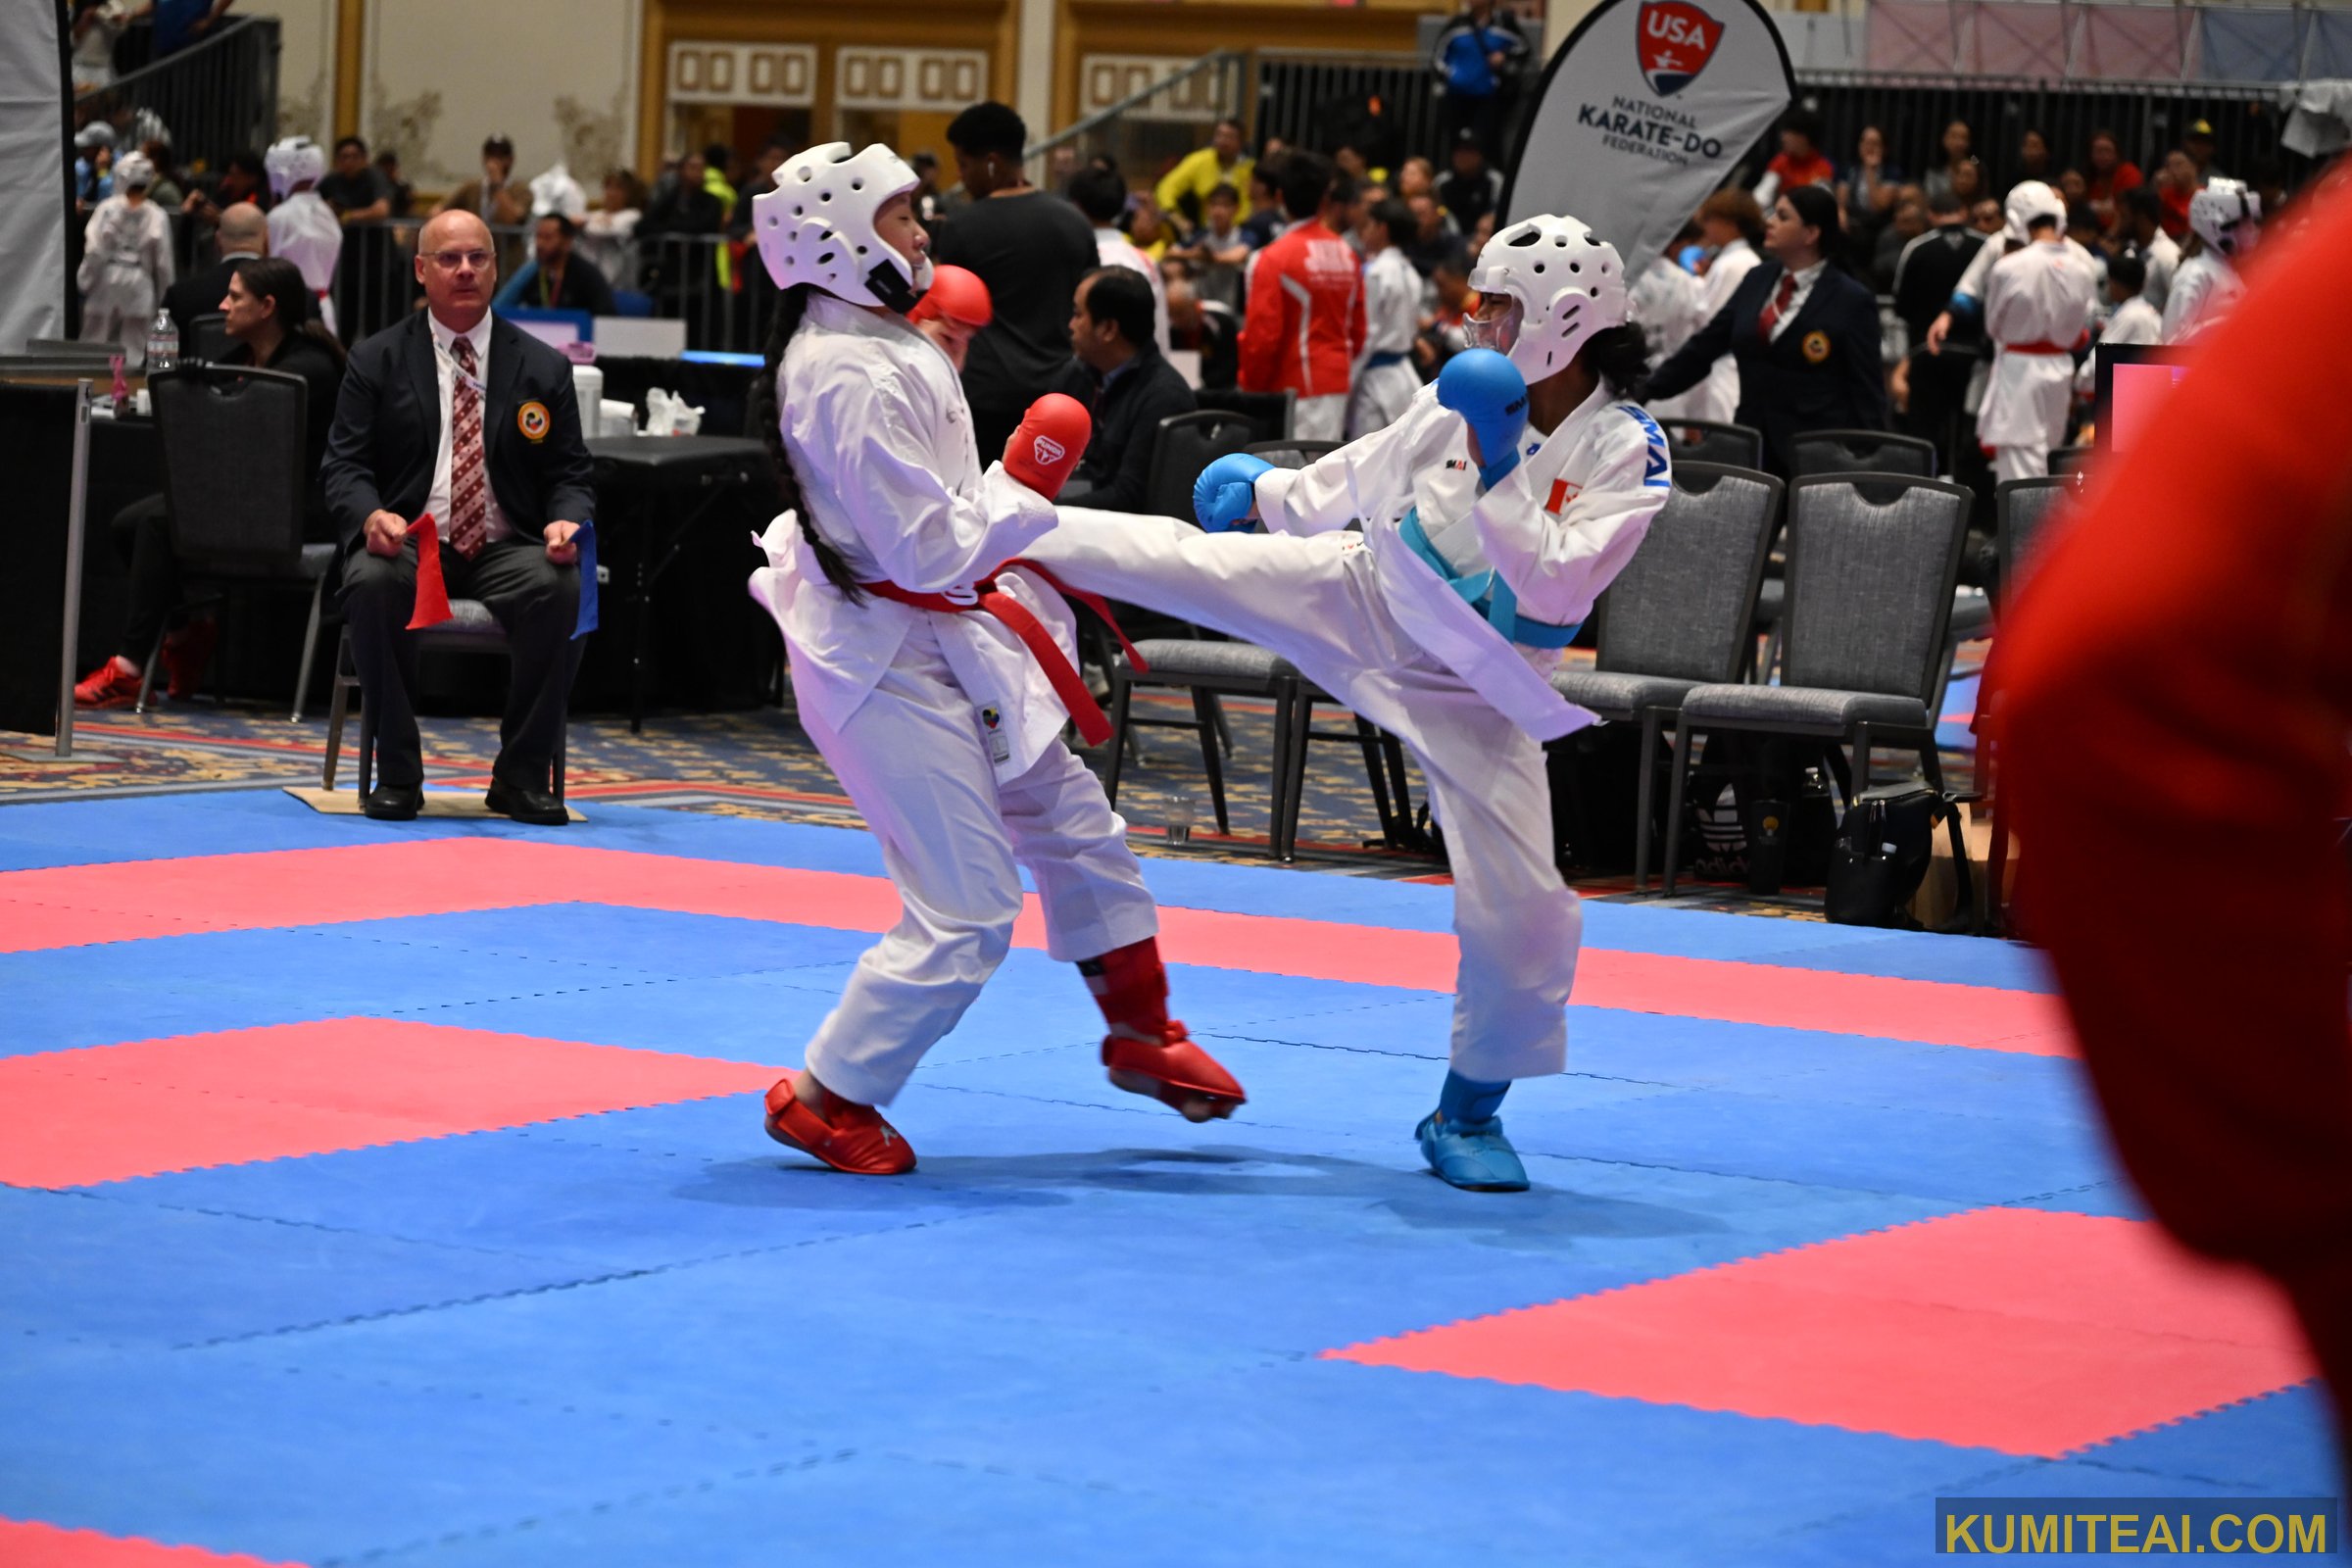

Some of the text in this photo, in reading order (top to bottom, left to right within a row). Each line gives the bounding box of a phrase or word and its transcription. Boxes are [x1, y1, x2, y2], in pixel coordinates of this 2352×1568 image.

[1647, 10, 1706, 51] USA
[1613, 96, 1697, 128] NATIONAL
[1578, 103, 1722, 159] KARATE-DO
[1601, 133, 1689, 166] FEDERATION
[1615, 405, 1671, 487] SMAI
[1446, 459, 1467, 471] SMAI
